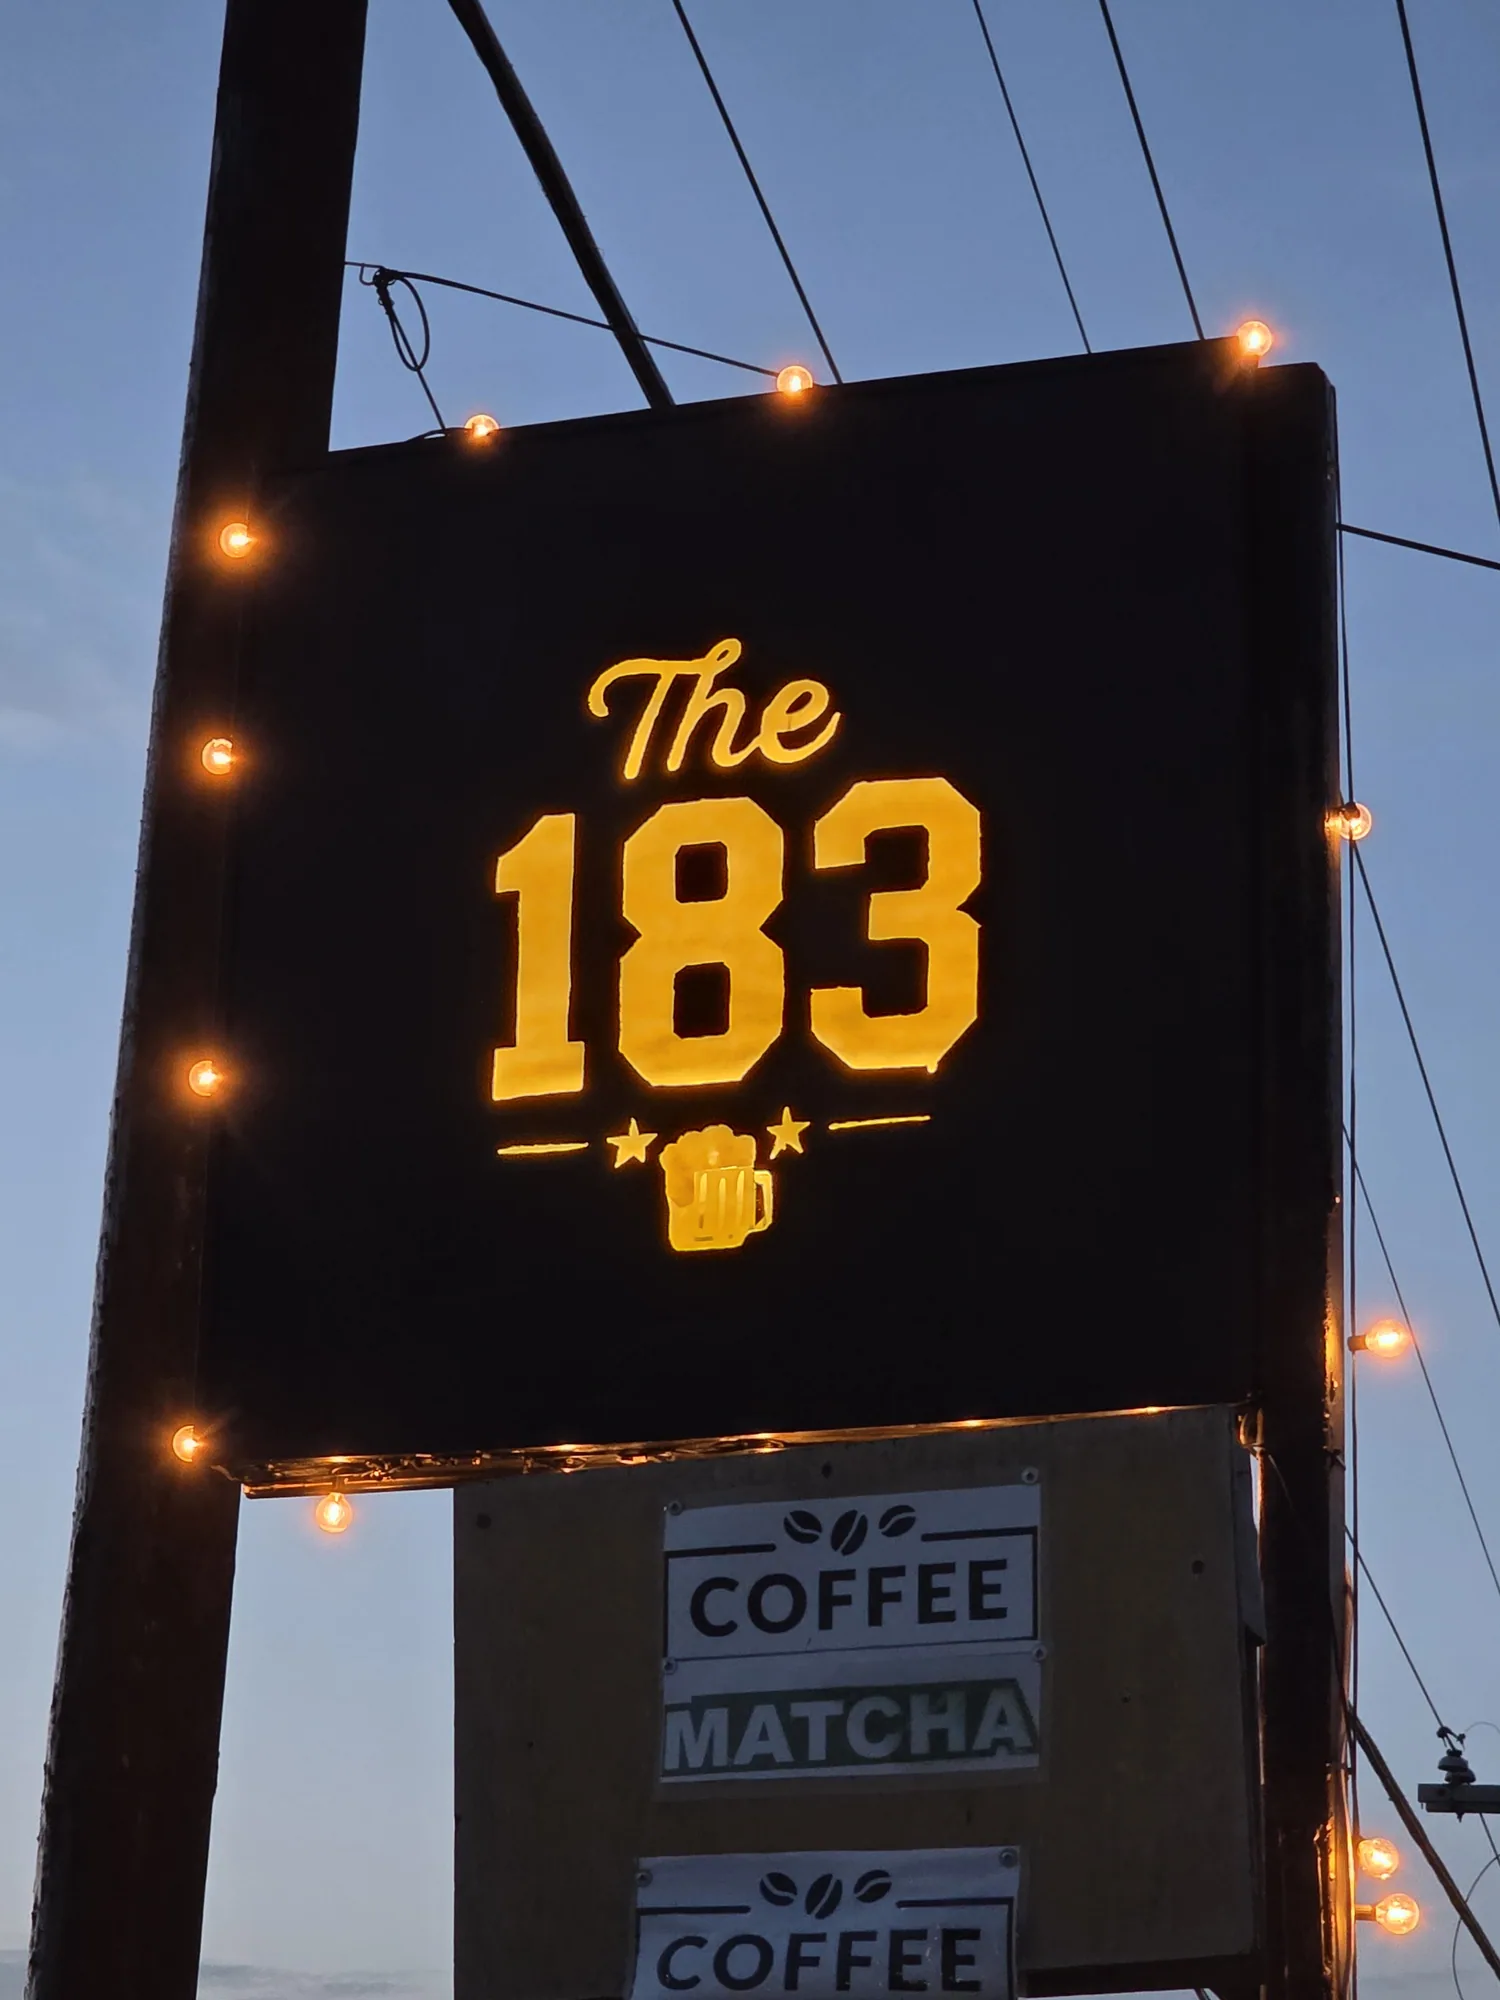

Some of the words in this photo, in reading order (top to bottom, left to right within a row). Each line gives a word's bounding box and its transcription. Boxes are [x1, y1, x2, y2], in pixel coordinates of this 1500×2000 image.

[588, 638, 842, 780] The
[492, 777, 982, 1100] 183
[690, 1559, 1008, 1637] COFFEE
[664, 1687, 1034, 1771] MATCHA
[656, 1928, 983, 1992] COFFEE
